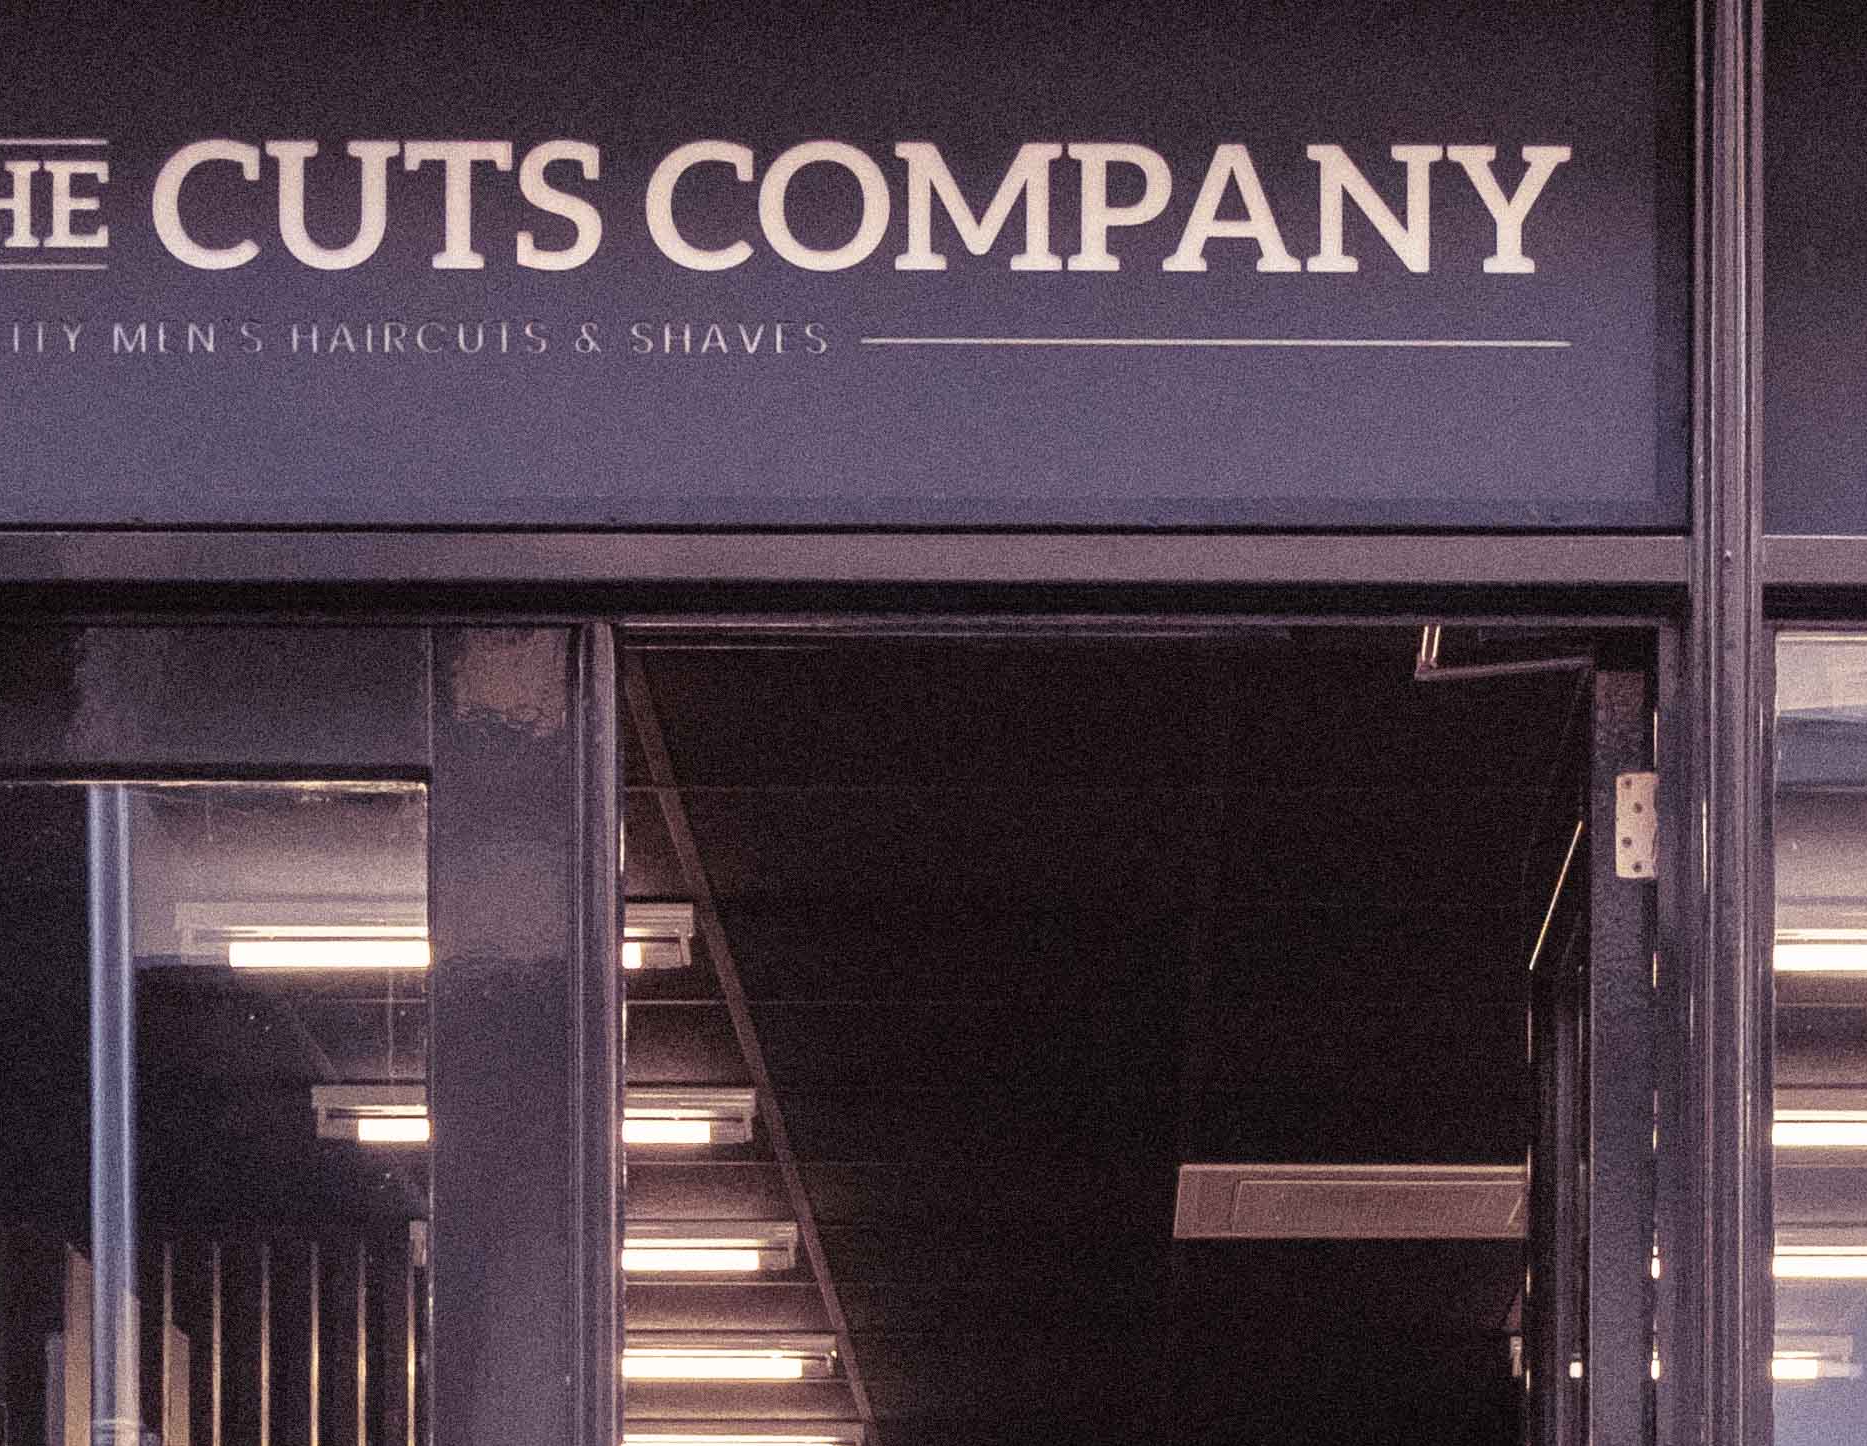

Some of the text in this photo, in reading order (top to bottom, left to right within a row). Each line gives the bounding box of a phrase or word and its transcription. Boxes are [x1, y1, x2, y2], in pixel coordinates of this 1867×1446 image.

[151, 138, 603, 272] CUTS
[644, 139, 1572, 275] COMPANY
[290, 321, 551, 354] HAIRCUTS
[571, 321, 601, 354] &
[627, 321, 832, 354] SHAVES
